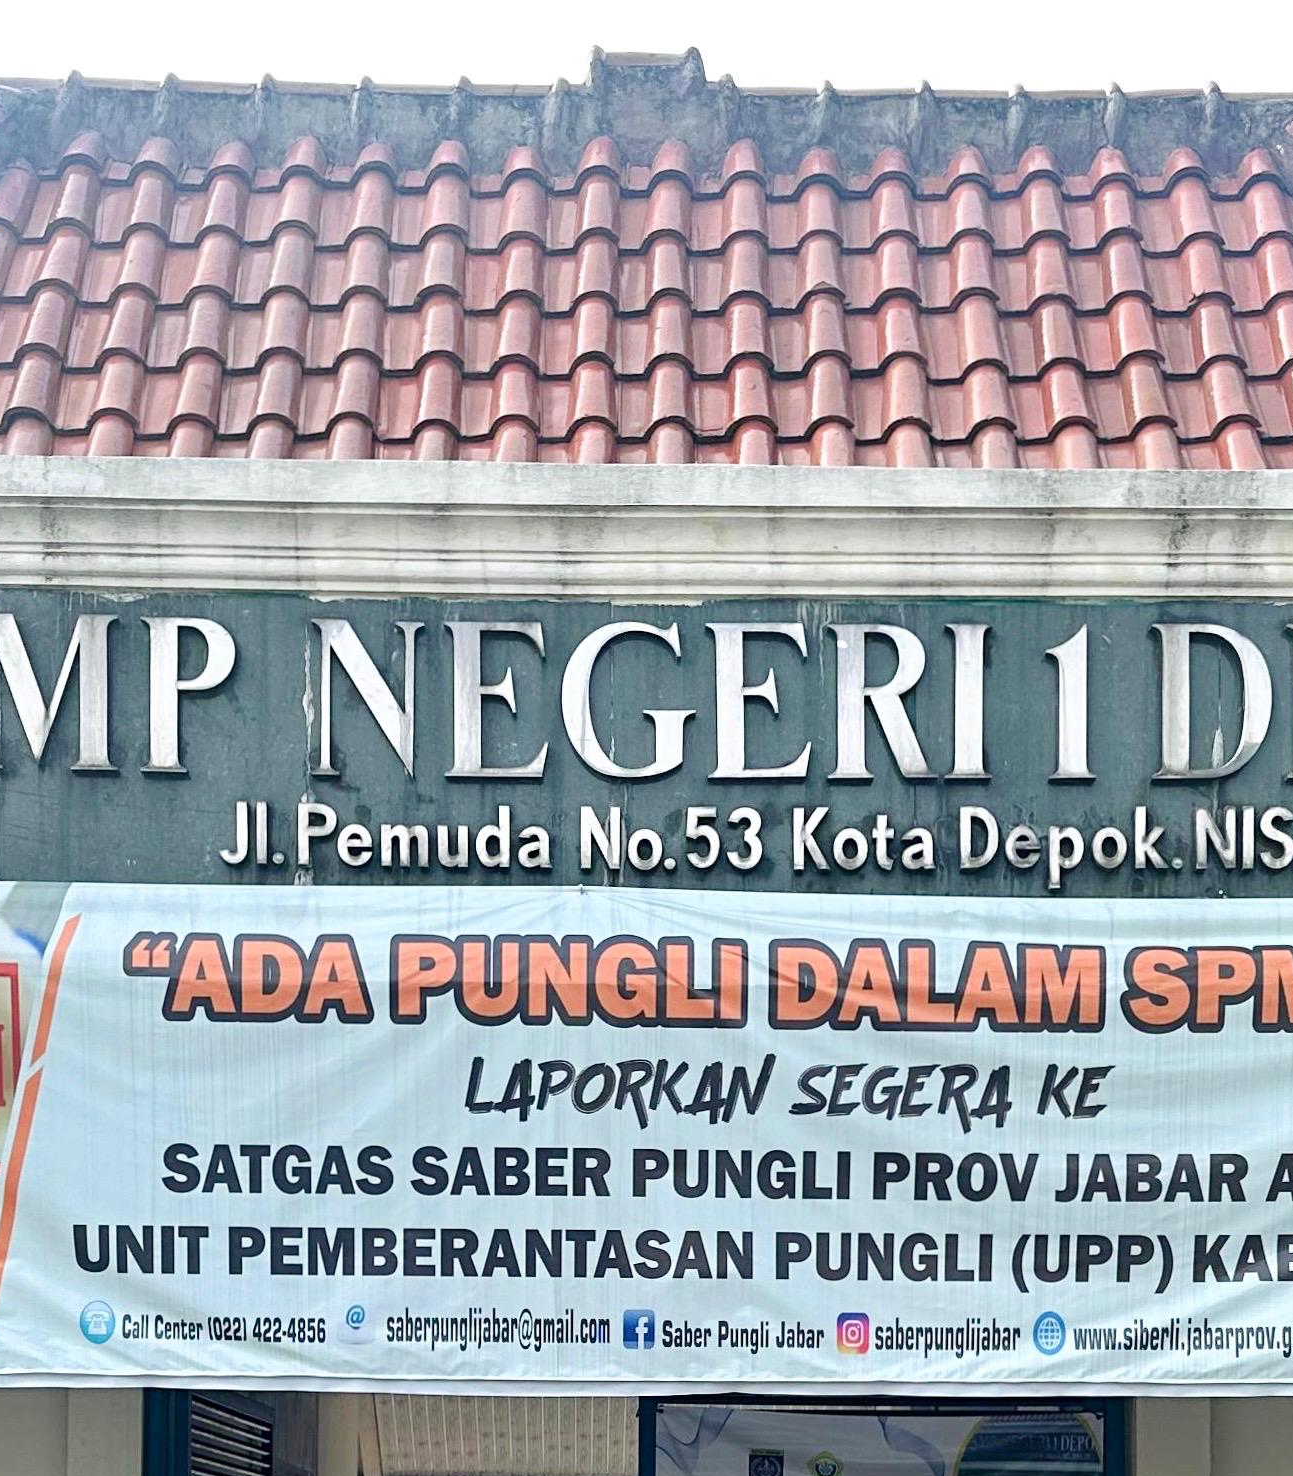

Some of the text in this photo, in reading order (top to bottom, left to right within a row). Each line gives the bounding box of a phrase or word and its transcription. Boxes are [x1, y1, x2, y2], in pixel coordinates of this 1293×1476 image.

[312, 619, 993, 783] NEGERI
[1045, 622, 1096, 781] 1
[580, 805, 763, 870] No.53
[793, 805, 935, 871] Kota
[390, 934, 748, 1029] PUNGLI
[768, 936, 1104, 1031] DALAM
[465, 1053, 1115, 1134] LAPORKAN SEGERA KE
[162, 1143, 394, 1195] SATGAS
[410, 1146, 609, 1197] SABER
[632, 1148, 849, 1200] PUNGLI
[872, 1151, 1039, 1201] PROV
[1055, 1152, 1249, 1203] JABAR
[73, 1223, 208, 1275] UNIT
[228, 1225, 752, 1280] PEMBERANTASAN
[775, 1231, 993, 1283] PUNGLI
[1011, 1233, 1173, 1292] (UPP)
[121, 1315, 326, 1343] Call Center (022) 422-4856
[386, 1307, 610, 1351] saberpunglijabar@gmail.com
[661, 1320, 824, 1354] Saber Pungli Jabar
[875, 1318, 1020, 1358] saberpunglijabar
